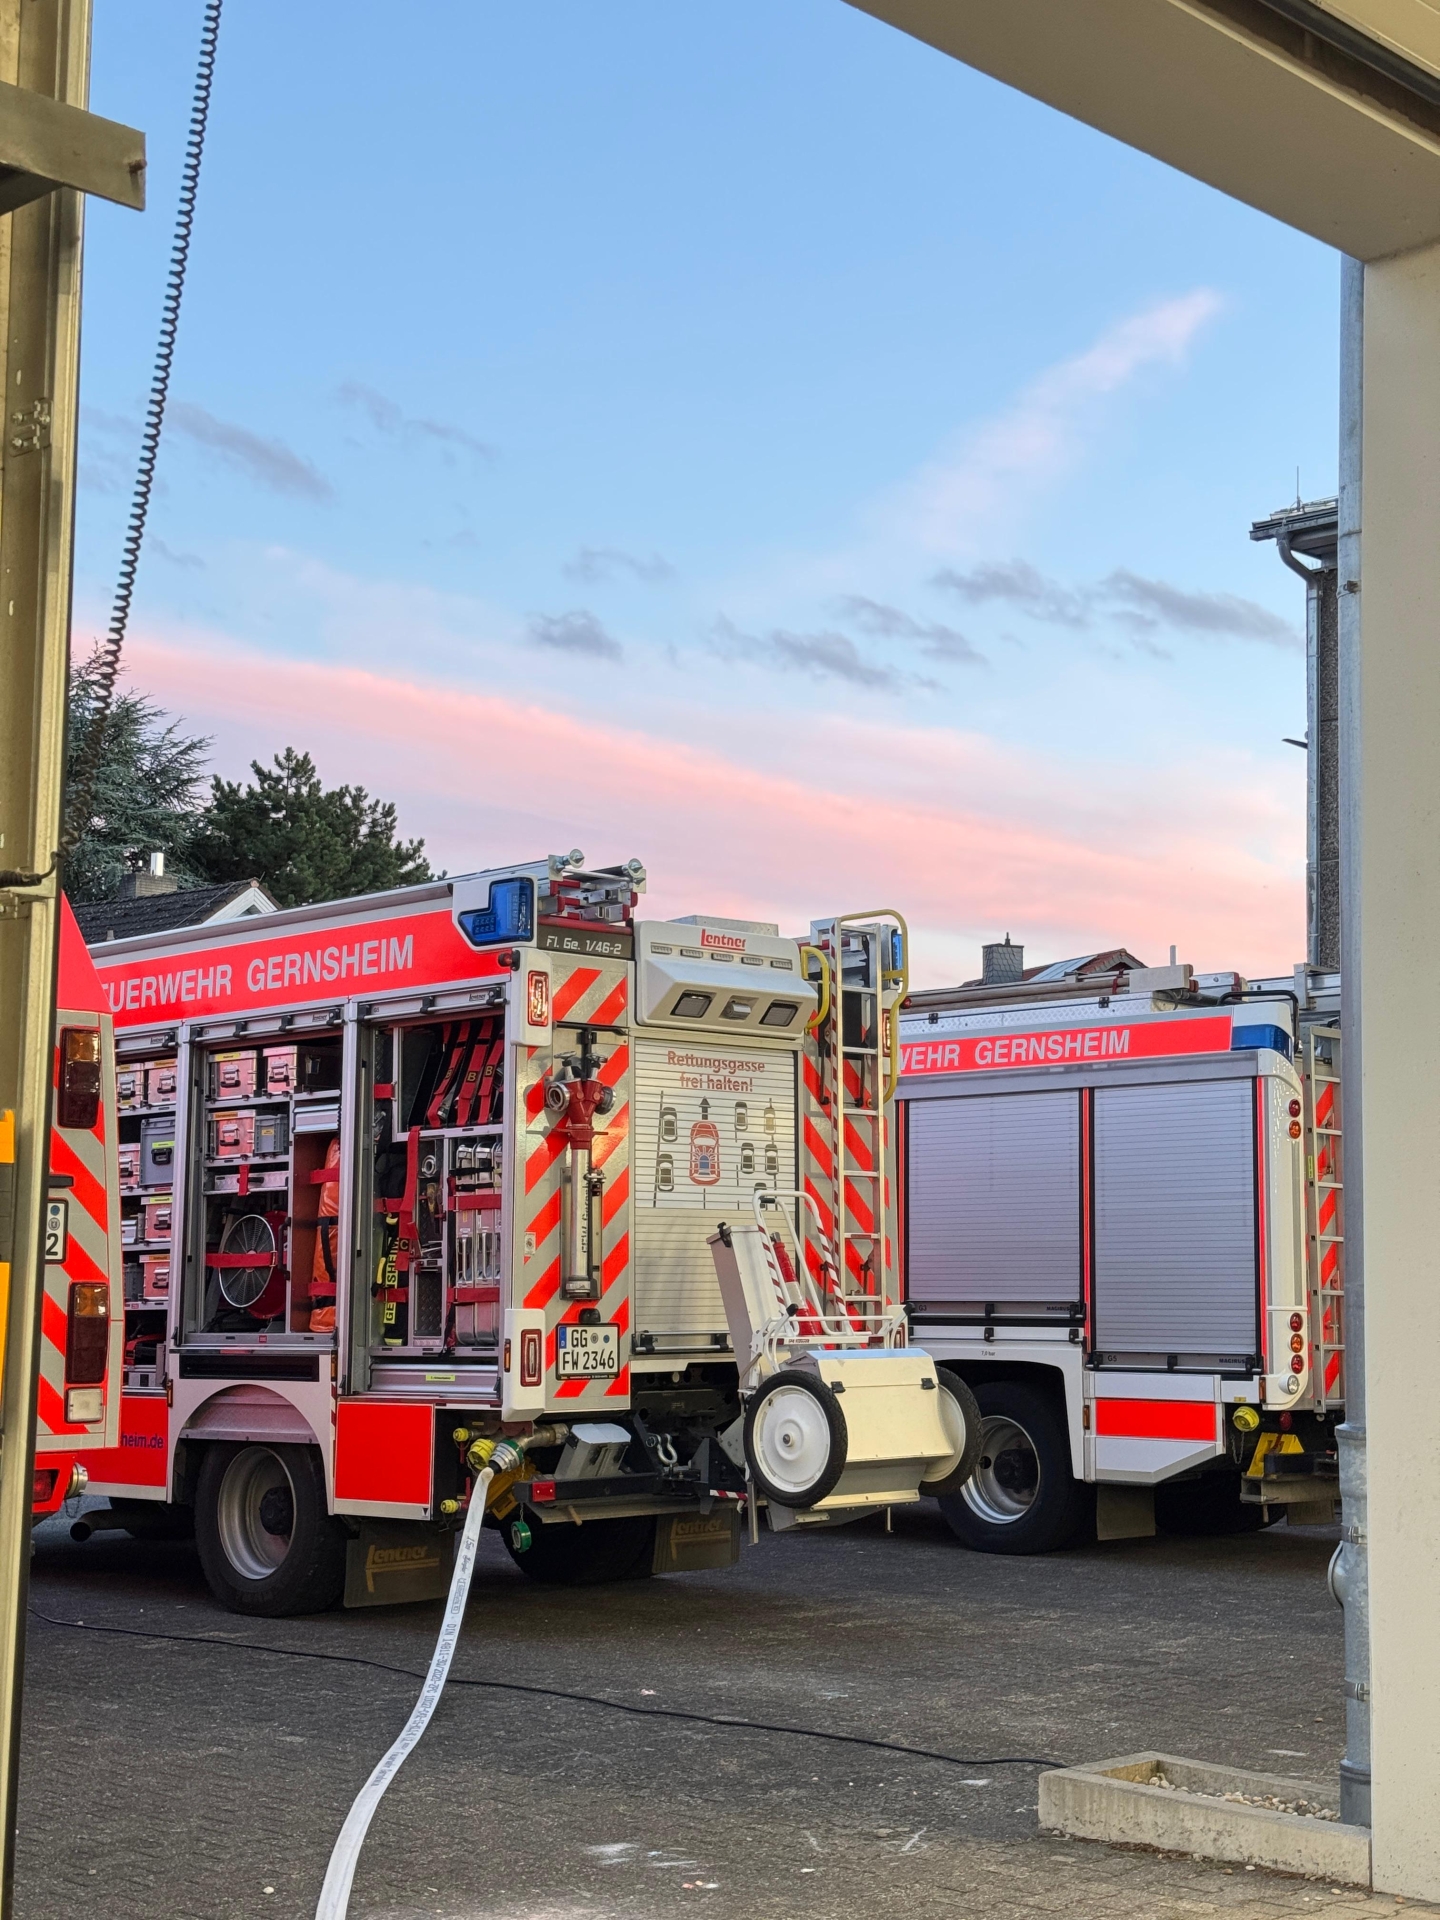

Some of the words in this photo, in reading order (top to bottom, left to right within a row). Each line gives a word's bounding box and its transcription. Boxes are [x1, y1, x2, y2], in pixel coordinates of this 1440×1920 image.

[546, 935, 559, 948] Fl.
[563, 938, 580, 950] Ge.
[586, 940, 622, 955] 1/46-2
[701, 929, 746, 951] Lentner
[101, 964, 232, 1012] UERWEHR
[247, 934, 414, 992] GERNSHEIM
[975, 1030, 1130, 1065] GERNSHEIM
[485, 1065, 493, 1076] B
[667, 1051, 765, 1074] Rettungsgasse
[467, 1072, 477, 1081] B
[680, 1071, 703, 1088] frei
[707, 1074, 753, 1092] halten!
[46, 1233, 59, 1256] 2
[571, 1329, 588, 1348] GG
[562, 1349, 579, 1370] FW
[583, 1348, 615, 1370] 2346
[121, 1431, 164, 1449] heim.de
